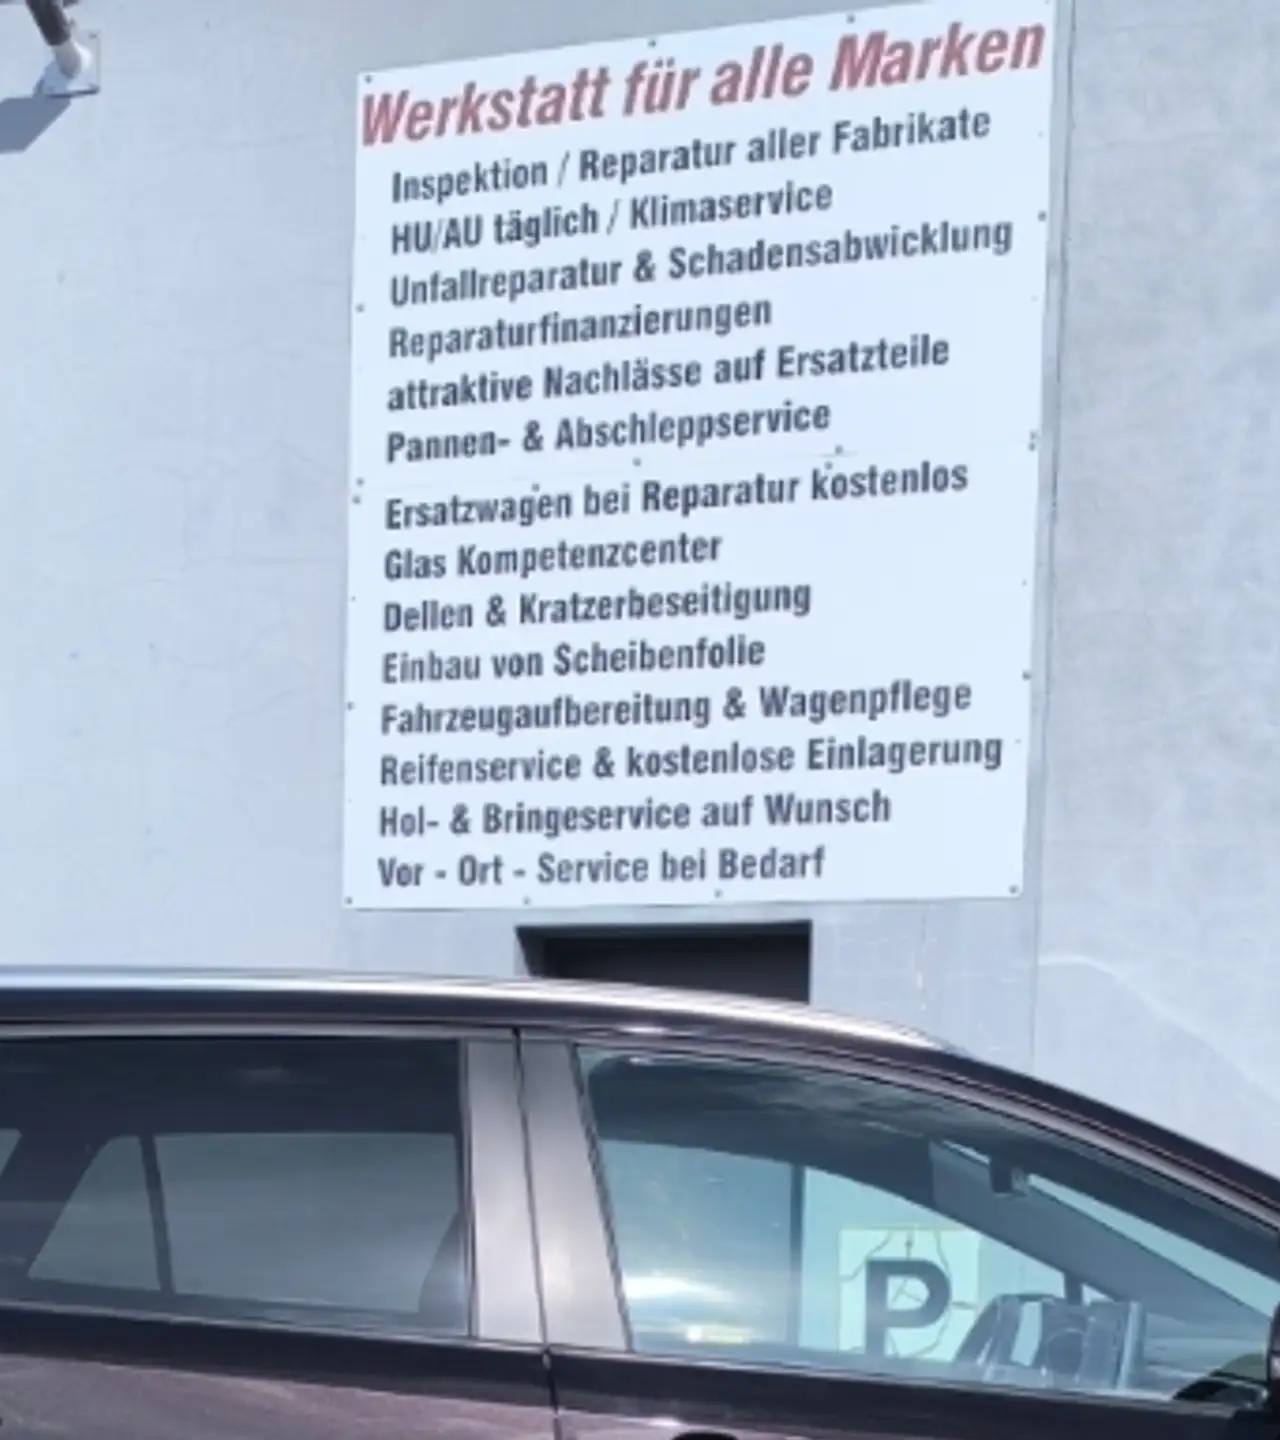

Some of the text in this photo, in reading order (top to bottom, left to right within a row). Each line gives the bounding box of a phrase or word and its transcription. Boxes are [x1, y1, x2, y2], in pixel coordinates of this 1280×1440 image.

[362, 23, 1046, 146] Werkstatt für alle Marken
[391, 107, 992, 206] Inspektion / Reparatur aller Fabrikate
[391, 179, 833, 256] HU/AU täglich / Klimaservice
[390, 220, 1013, 308] Unfallreparatur & Schadensabwicklung
[388, 300, 773, 362] Reparaturfinanzierungen
[386, 333, 950, 413] attraktive Nachlässe auf Ersatzteile
[386, 399, 832, 465] Pannen- & Abschleppservice
[385, 459, 969, 531] Ersatzwagen bei Reparatur kostenlos
[383, 531, 723, 582] Glas Kompetenzcenter
[383, 581, 812, 633] Dellen & Kratzerbeseitigung
[381, 633, 766, 685] Einbau von Scheibenfolie
[380, 678, 973, 737] Fahrzeugaufbereitung & Wagenpflege
[379, 736, 1004, 787] Reifenservice & kostenlose Einlagerung
[379, 788, 892, 840] Hol- & Bringeservice auf Wunsch
[377, 857, 425, 888] Vor
[457, 853, 504, 887] Ort
[536, 850, 649, 884] Service
[660, 847, 707, 882] bei
[718, 844, 826, 880] Bedarf
[866, 1258, 952, 1357] P
